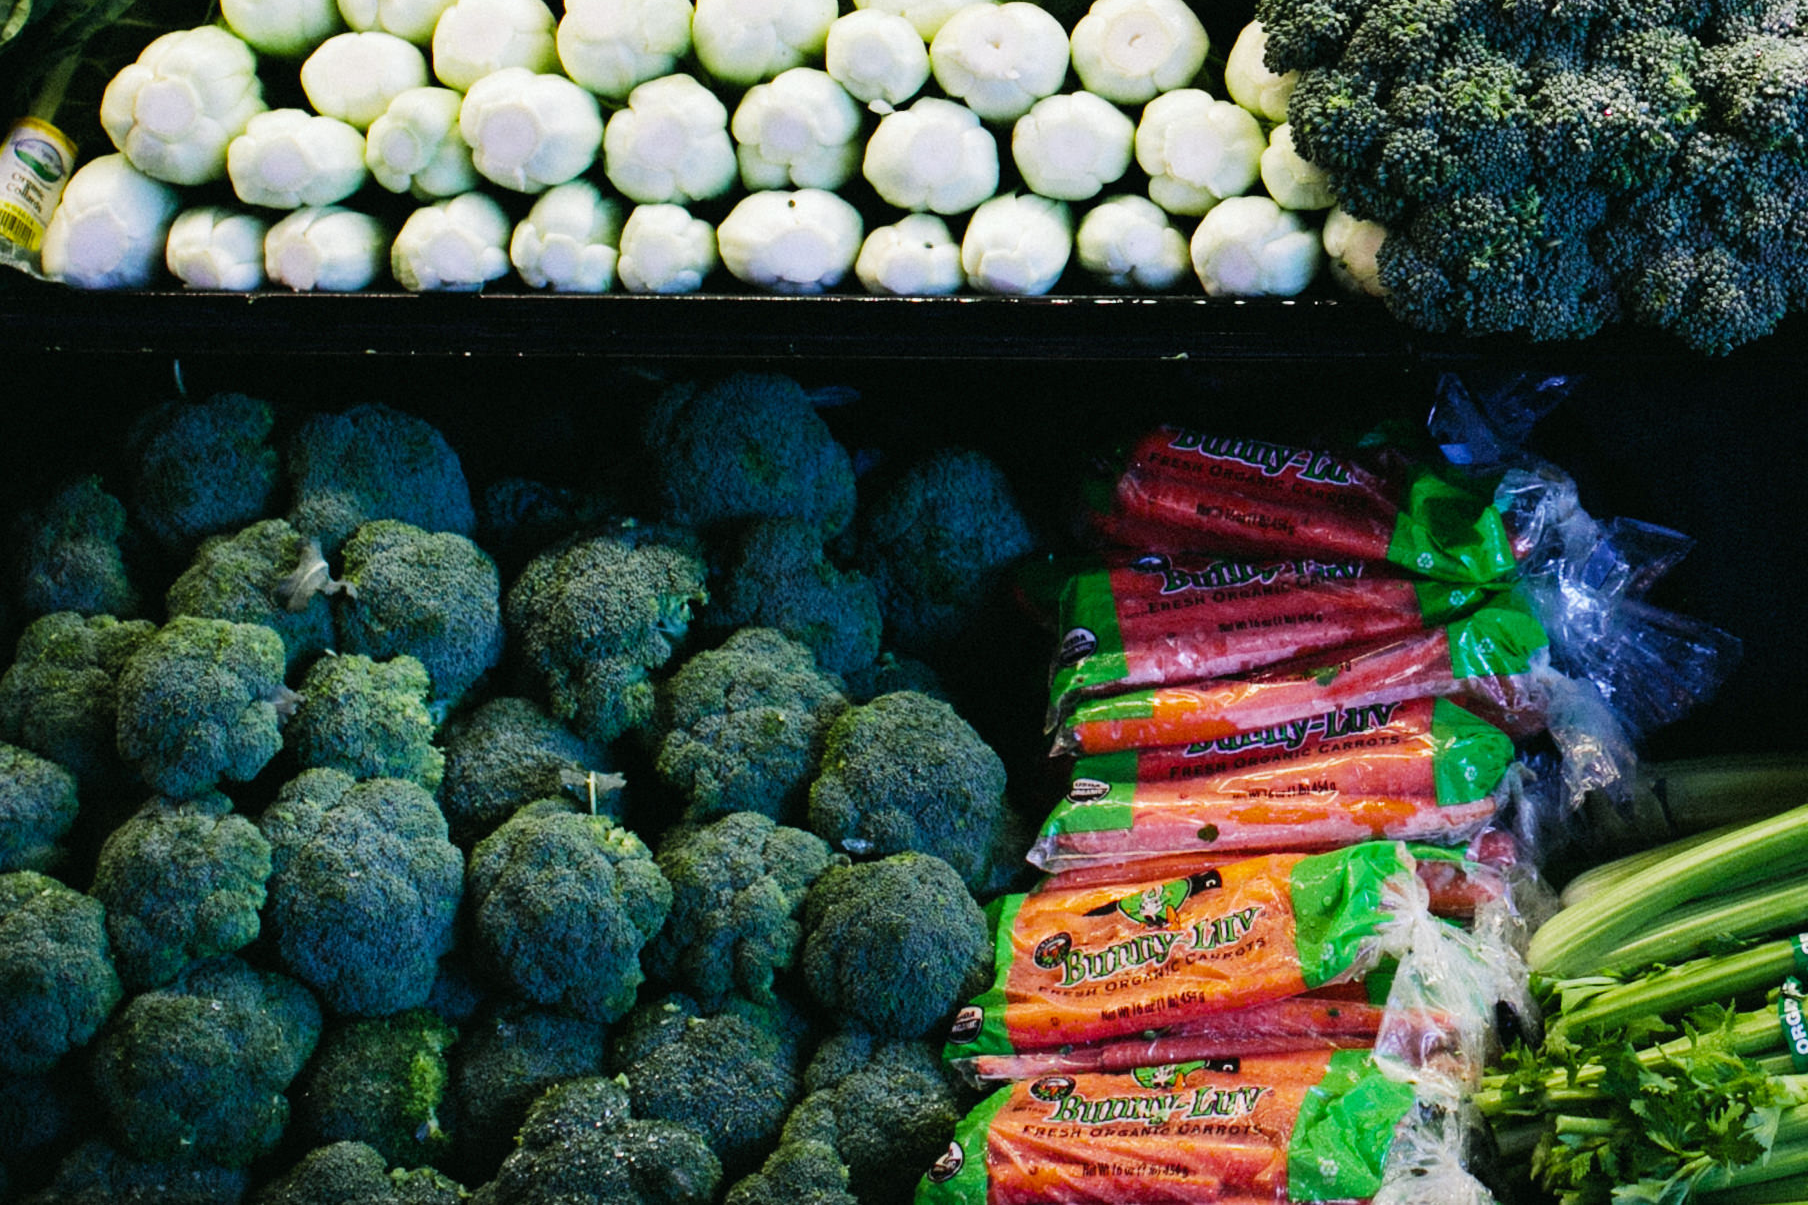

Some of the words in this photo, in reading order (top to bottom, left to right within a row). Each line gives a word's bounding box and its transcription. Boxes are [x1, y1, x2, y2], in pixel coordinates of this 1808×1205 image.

[1150, 451, 1202, 474] FRESH
[1209, 463, 1285, 493] ORGANIC
[1168, 431, 1359, 486] unny-Lu
[1147, 596, 1205, 614] FRESH
[1212, 582, 1290, 604] ORGANIC
[1170, 760, 1228, 779] FRESH
[1234, 747, 1311, 769] ORGANIC
[1318, 735, 1400, 754] CARROTS
[1055, 904, 1265, 988] Bunny-Luv
[1104, 958, 1180, 993] ORGANIC
[1184, 936, 1267, 965] CARROTS
[1117, 1005, 1131, 1020] Wt
[1132, 1003, 1143, 1016] 16
[1144, 1004, 1155, 1014] oz
[1044, 1086, 1272, 1126] Bunny-Luv
[1023, 1125, 1081, 1138] FRESH
[1089, 1123, 1170, 1139] ORGANIC
[1178, 1122, 1264, 1137] CARROTS
